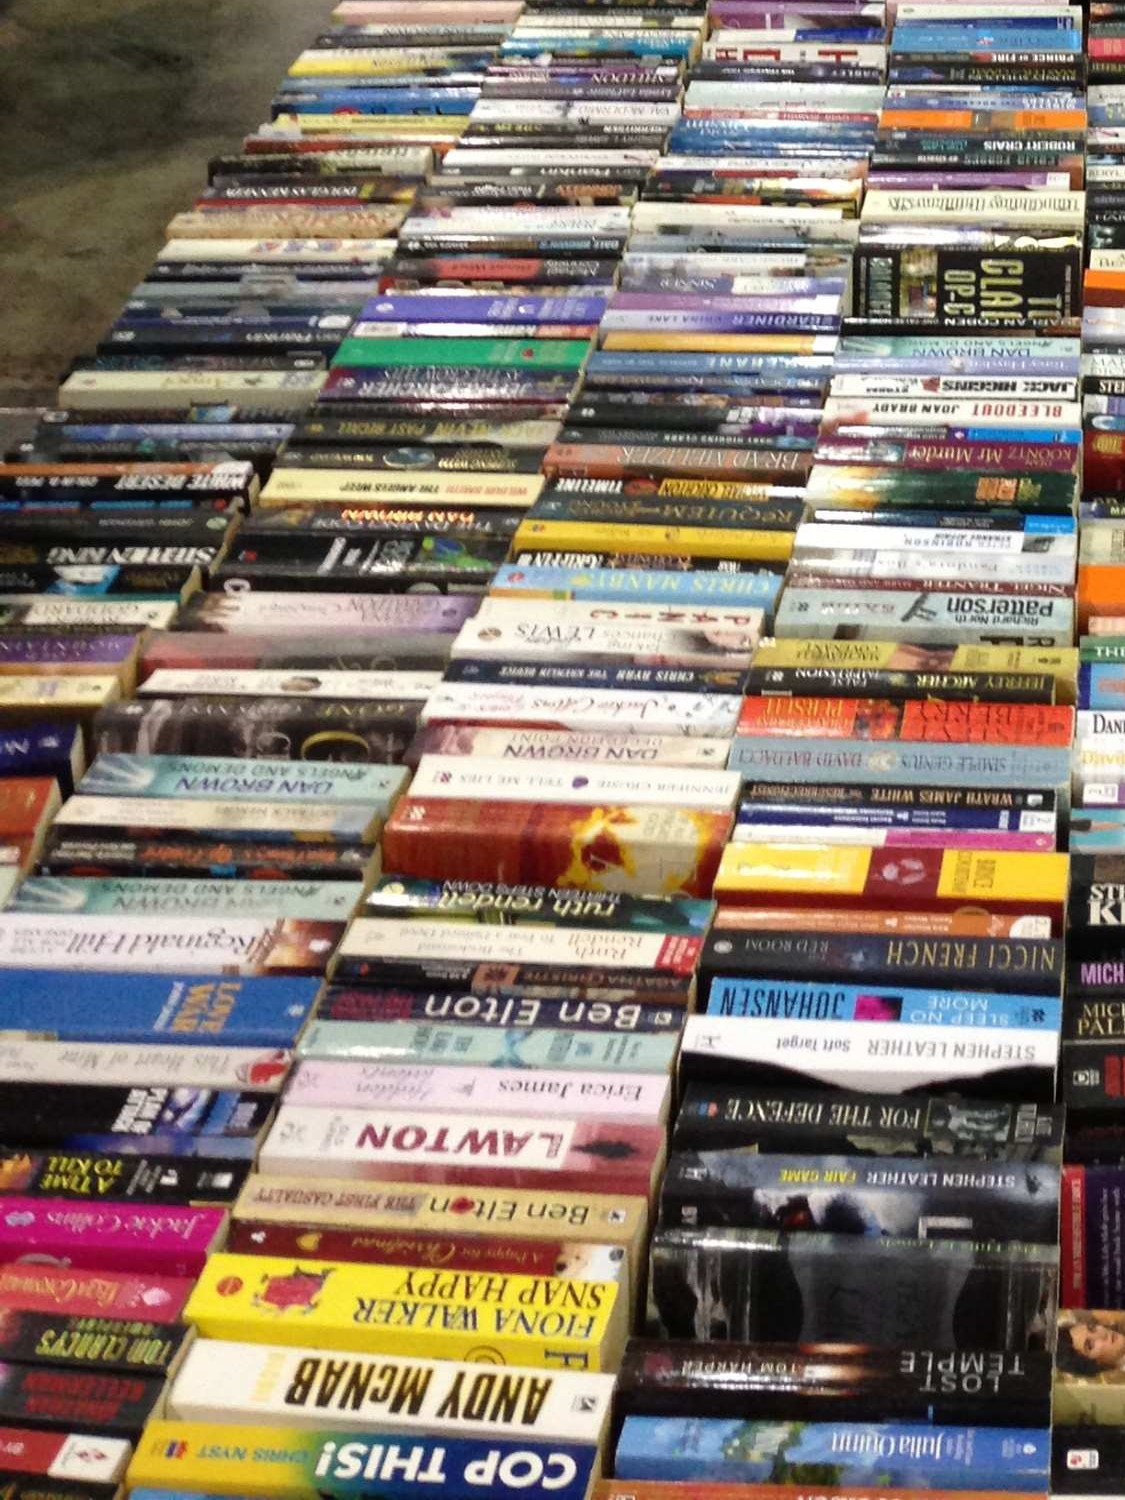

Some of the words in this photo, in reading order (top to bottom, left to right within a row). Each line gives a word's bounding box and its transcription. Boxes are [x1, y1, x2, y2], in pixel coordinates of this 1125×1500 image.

[972, 403, 1062, 418] BLEEDOUT
[909, 445, 972, 461] Murder
[174, 775, 271, 794] BROWN
[886, 940, 978, 969] FRENCH
[985, 944, 1056, 973] NICCI
[424, 994, 541, 1025] Elton
[558, 1003, 641, 1030] Ben
[867, 1040, 948, 1058] LEATHER
[954, 1043, 1036, 1061] STEPHEN
[725, 1098, 824, 1123] DEFENCE
[829, 1104, 872, 1126] THE
[878, 1106, 921, 1128] FOR
[355, 1124, 564, 1159] LAWTON
[393, 1272, 509, 1302] HAPPY
[519, 1279, 606, 1309] SNAP
[352, 1298, 479, 1331] WALKER
[494, 1308, 596, 1339] FIONA
[898, 1350, 1024, 1376] TEMPLE
[284, 1357, 433, 1414] McNAB
[919, 1371, 1000, 1393] LOST
[437, 1371, 552, 1426] ANDY
[314, 1440, 446, 1482] THIS!
[464, 1450, 577, 1489] COP
